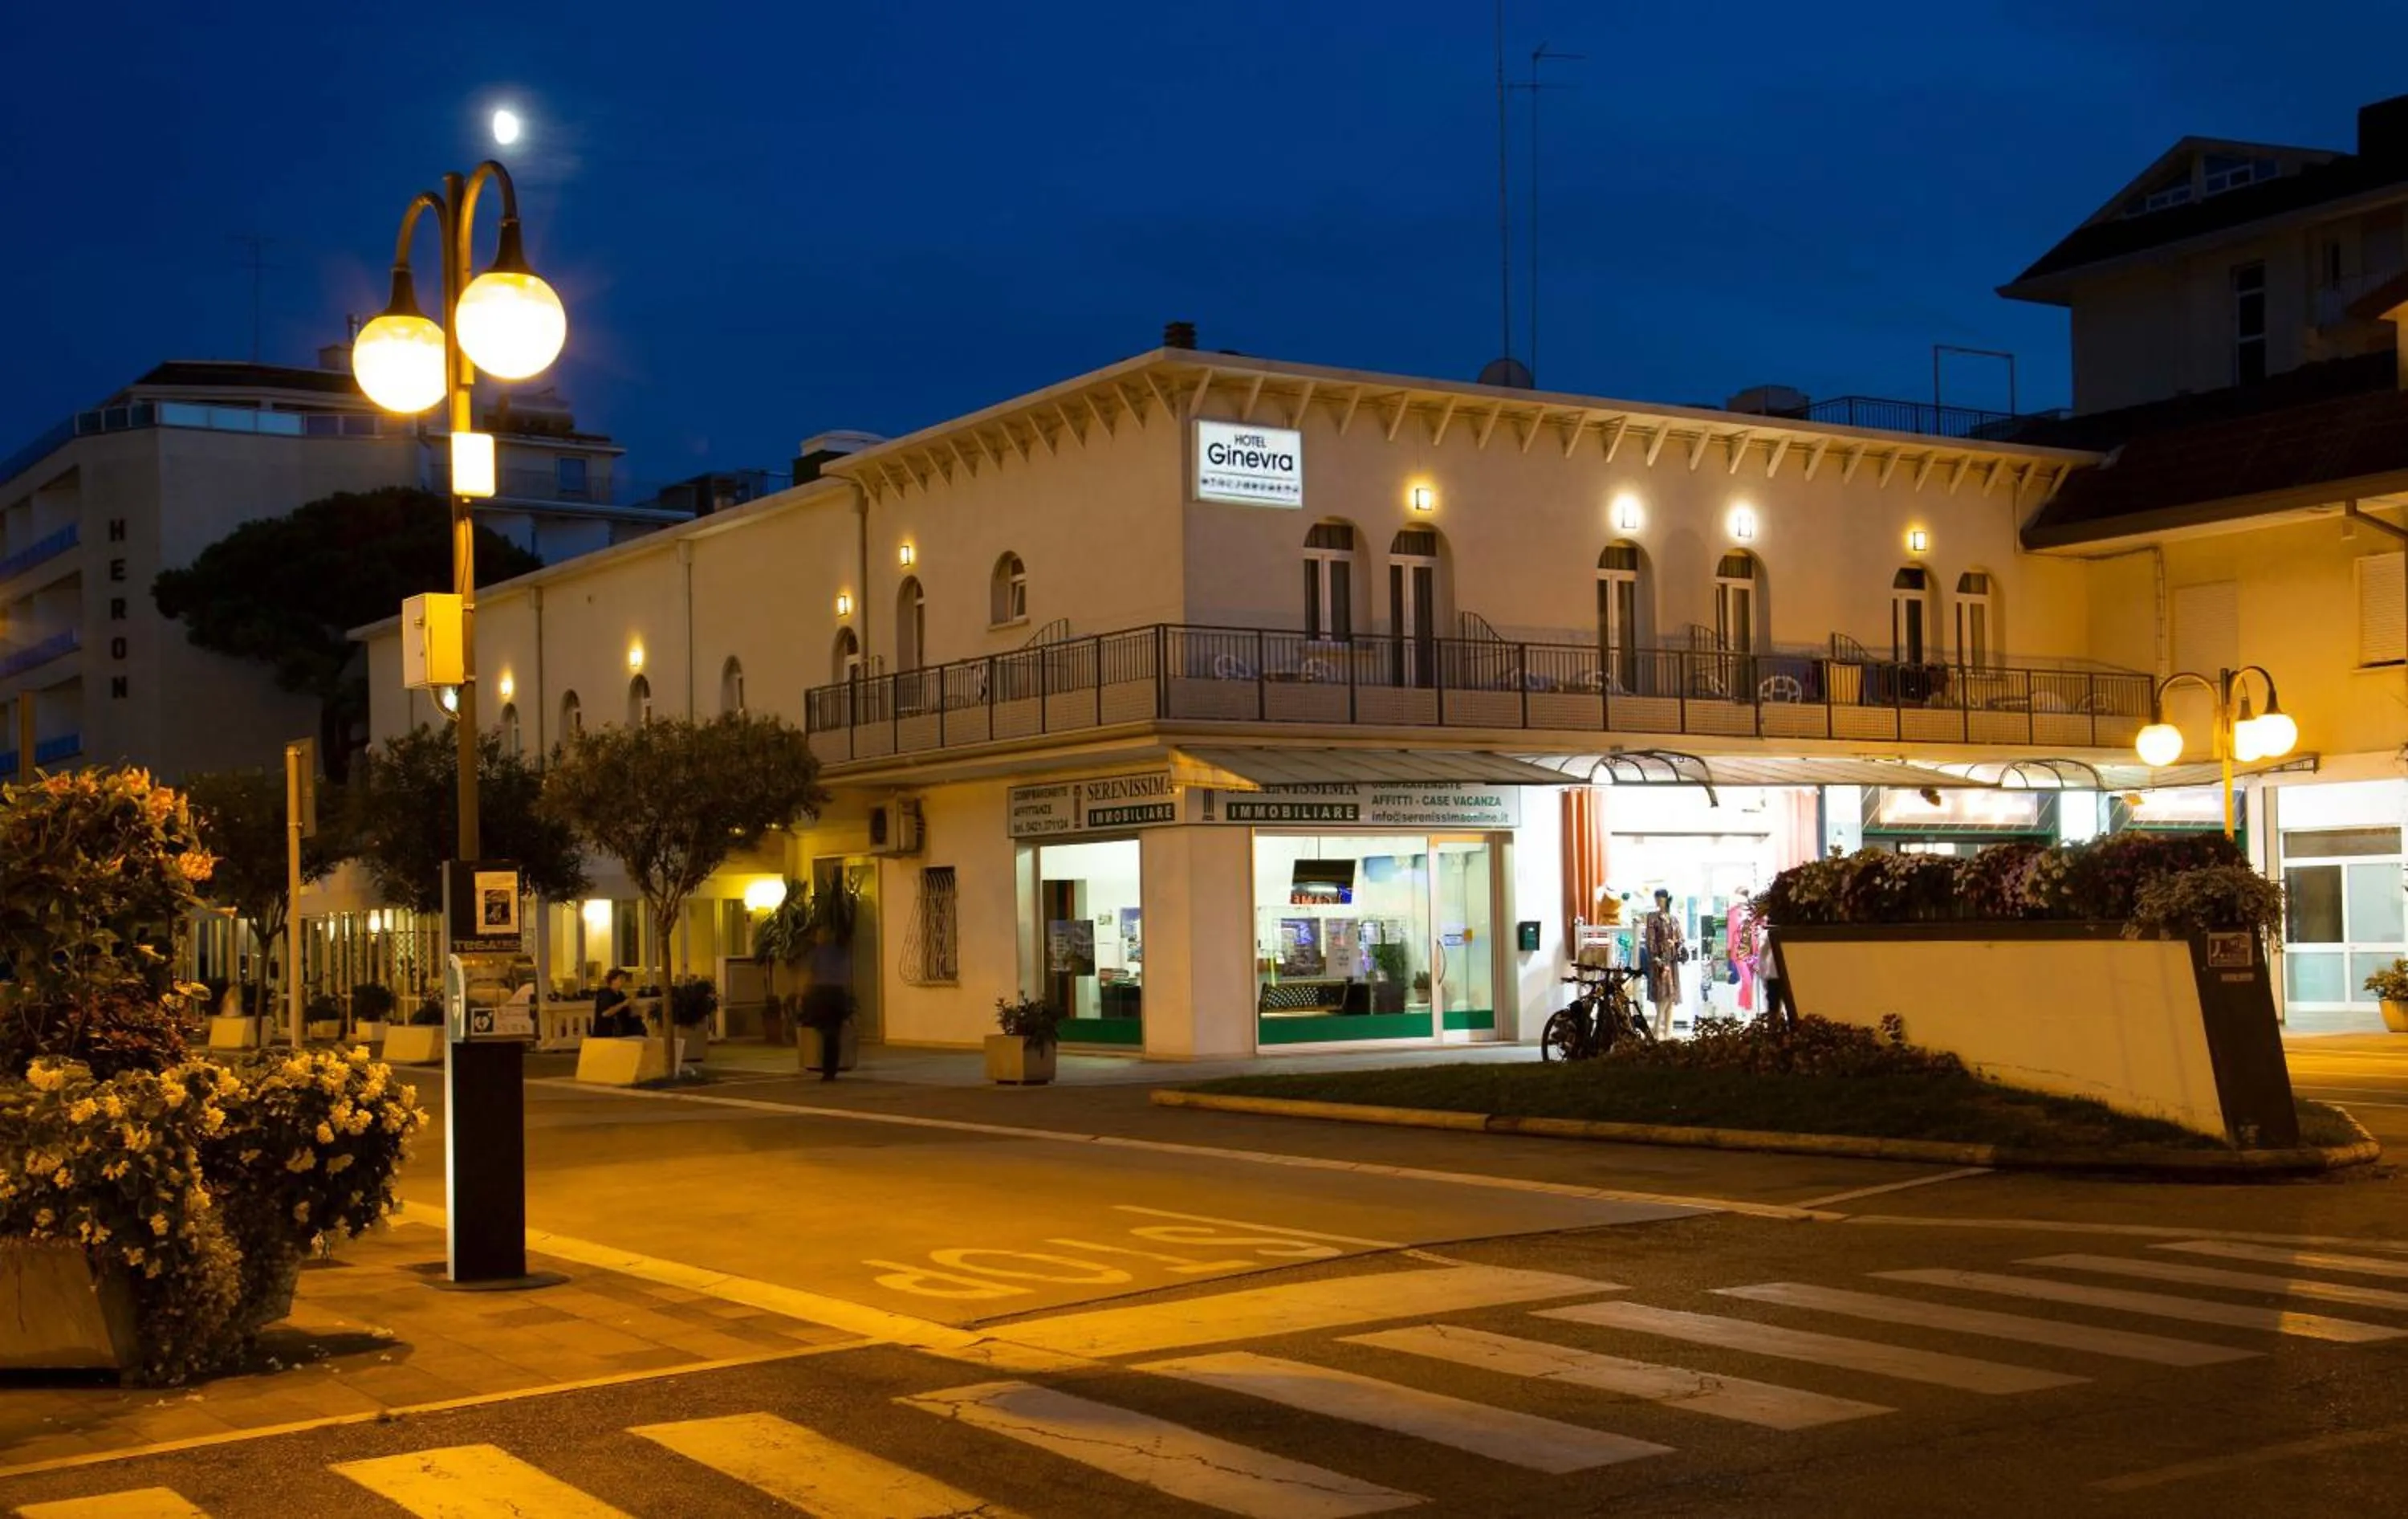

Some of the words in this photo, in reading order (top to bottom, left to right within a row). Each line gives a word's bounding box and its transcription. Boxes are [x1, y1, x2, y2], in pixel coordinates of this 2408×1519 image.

[1235, 434, 1267, 448] HOTEL
[1208, 442, 1293, 471] Ginevra
[109, 519, 128, 698] HERON
[1087, 776, 1174, 801] SERENISSIMA
[1231, 804, 1355, 819] IMMOBILIARE
[1372, 795, 1413, 805] AFFITTI
[1423, 796, 1451, 806] CASE
[1454, 796, 1502, 807] VACANZA
[1090, 804, 1172, 825] IMMOBILIARE
